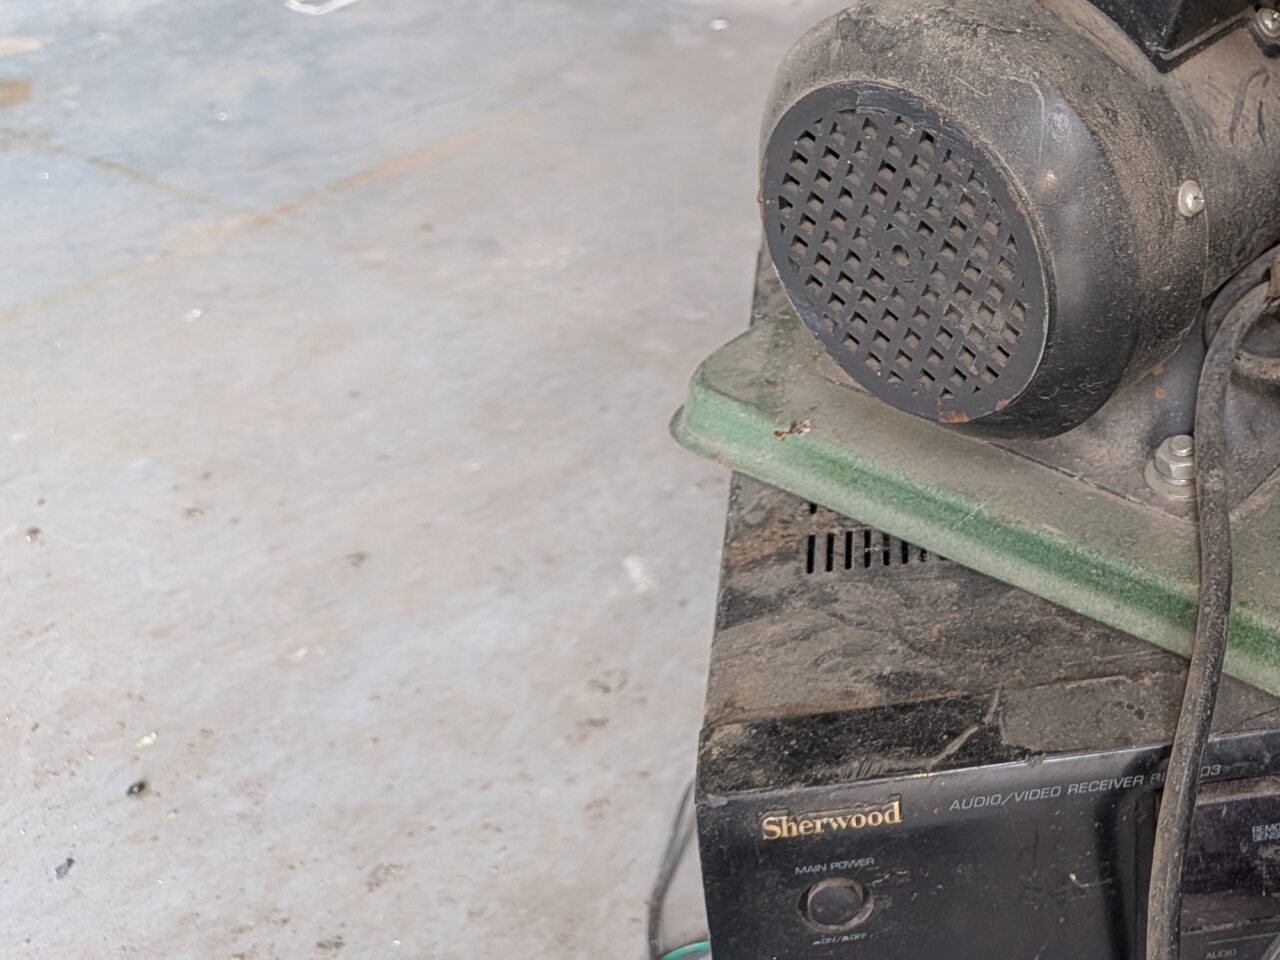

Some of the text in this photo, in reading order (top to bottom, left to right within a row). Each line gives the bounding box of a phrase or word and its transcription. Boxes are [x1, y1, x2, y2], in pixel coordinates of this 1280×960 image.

[949, 786, 1062, 811] AUDIO/VIDEO
[1067, 775, 1145, 795] RECEIVER
[762, 800, 903, 841] Sherwood
[795, 857, 875, 875] MAIN POWER
[1206, 948, 1237, 960] AUDIO
